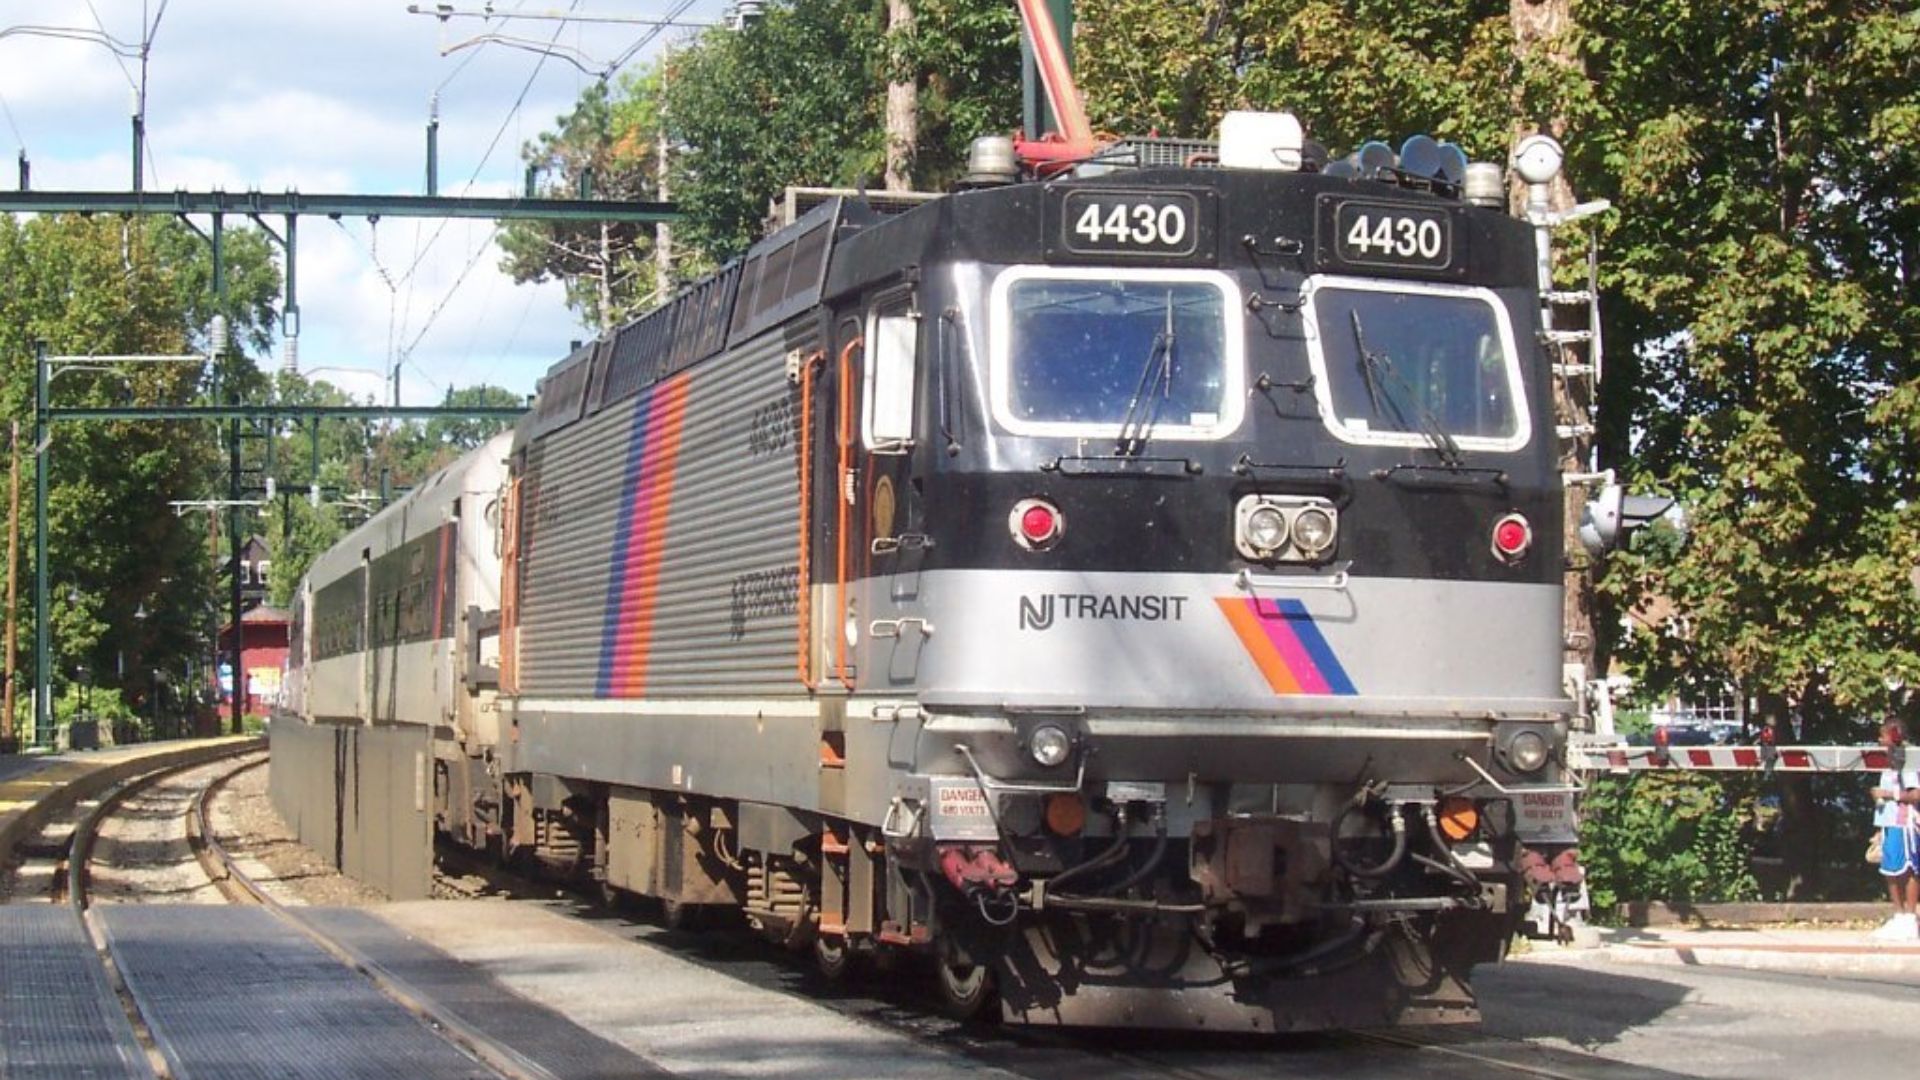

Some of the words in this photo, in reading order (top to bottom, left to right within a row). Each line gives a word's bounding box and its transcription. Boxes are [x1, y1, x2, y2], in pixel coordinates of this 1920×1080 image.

[1075, 203, 1186, 245] 4430
[1347, 215, 1442, 258] 4430
[1019, 594, 1054, 630] NJ
[1059, 594, 1188, 621] TRANSIT
